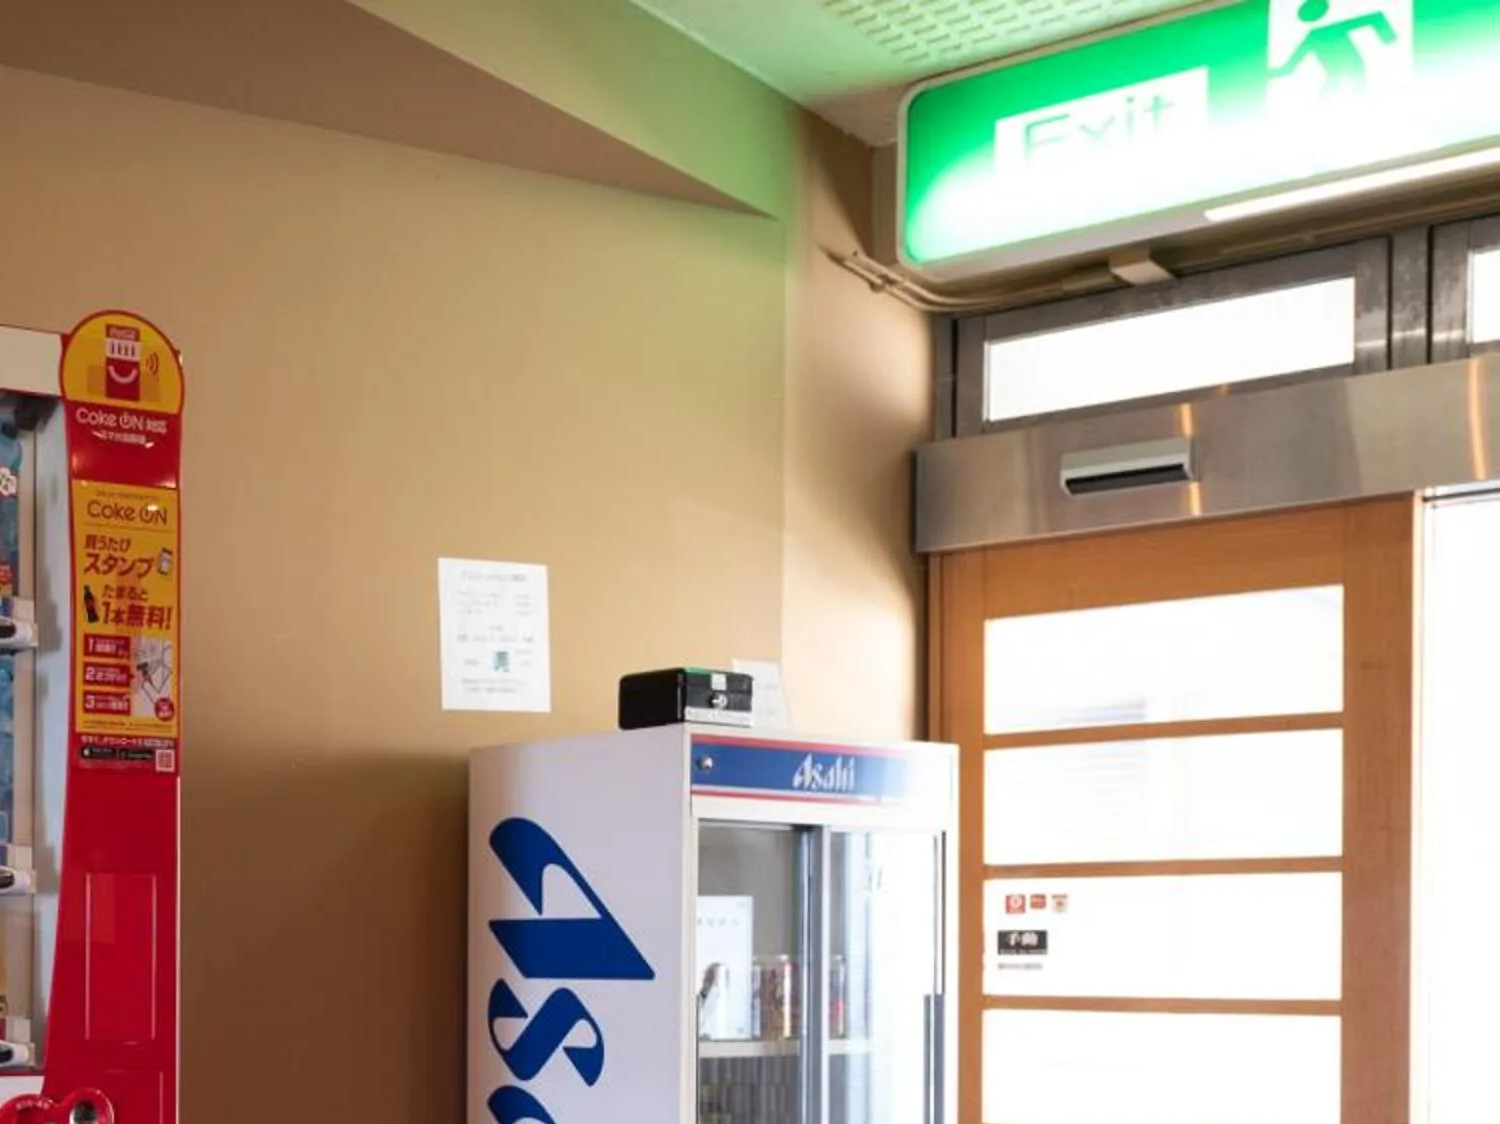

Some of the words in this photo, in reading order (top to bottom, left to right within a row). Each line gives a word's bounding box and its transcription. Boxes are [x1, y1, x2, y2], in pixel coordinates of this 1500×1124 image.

[1024, 94, 1175, 166] Exit
[76, 407, 116, 427] Coke
[120, 413, 143, 430] ON
[87, 500, 135, 521] Coke
[84, 552, 154, 578] スタンプ
[793, 753, 855, 791] Asahi
